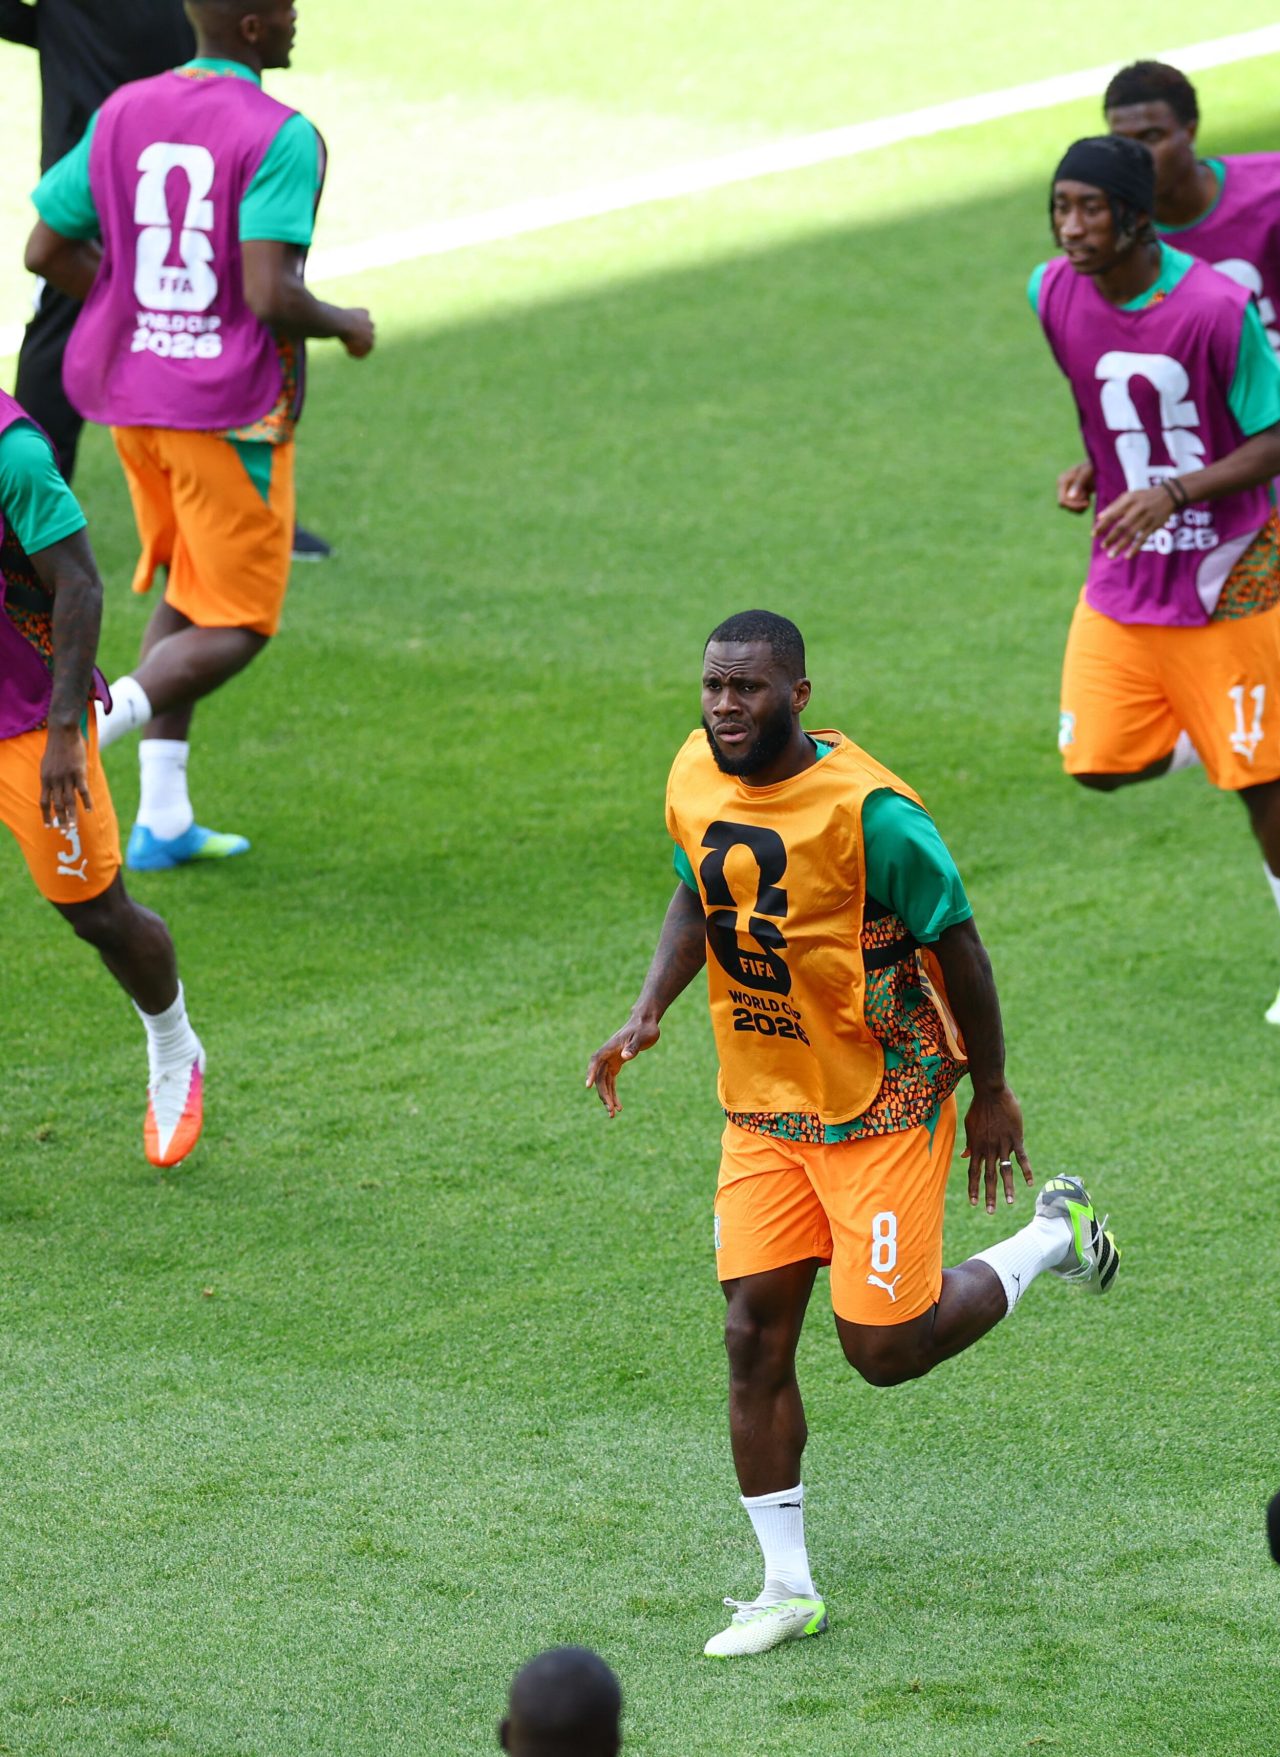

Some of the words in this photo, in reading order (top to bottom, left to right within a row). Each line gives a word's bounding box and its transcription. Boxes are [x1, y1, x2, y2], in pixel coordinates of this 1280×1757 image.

[158, 278, 193, 292] FFA
[130, 327, 222, 359] 2026
[1228, 684, 1266, 743] 11
[739, 956, 777, 980] FIFA
[728, 989, 780, 1012] WORLD
[733, 1007, 811, 1047] 2026
[871, 1211, 897, 1273] 8
